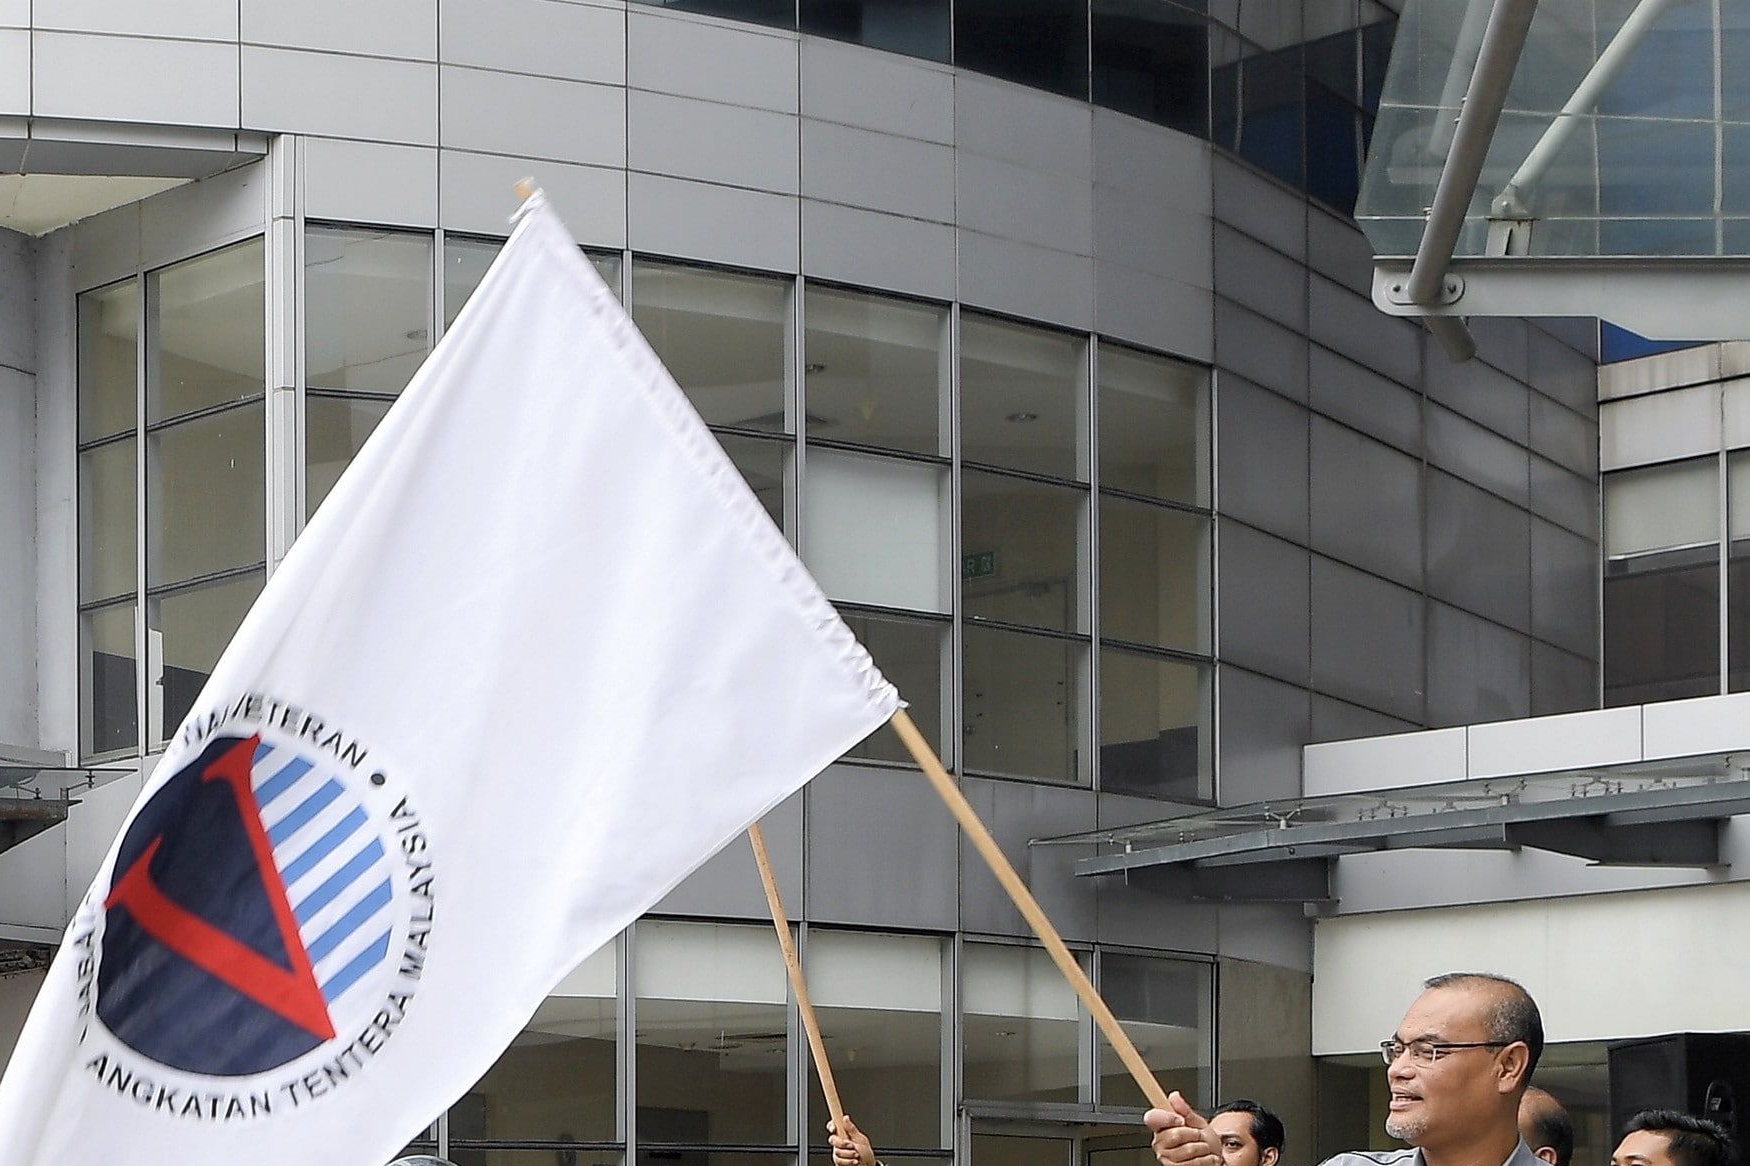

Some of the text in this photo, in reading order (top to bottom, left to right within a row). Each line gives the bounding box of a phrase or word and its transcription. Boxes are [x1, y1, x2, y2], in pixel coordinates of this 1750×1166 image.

[88, 796, 435, 1120] ANGKATAN TENTERA MALAYSIA
